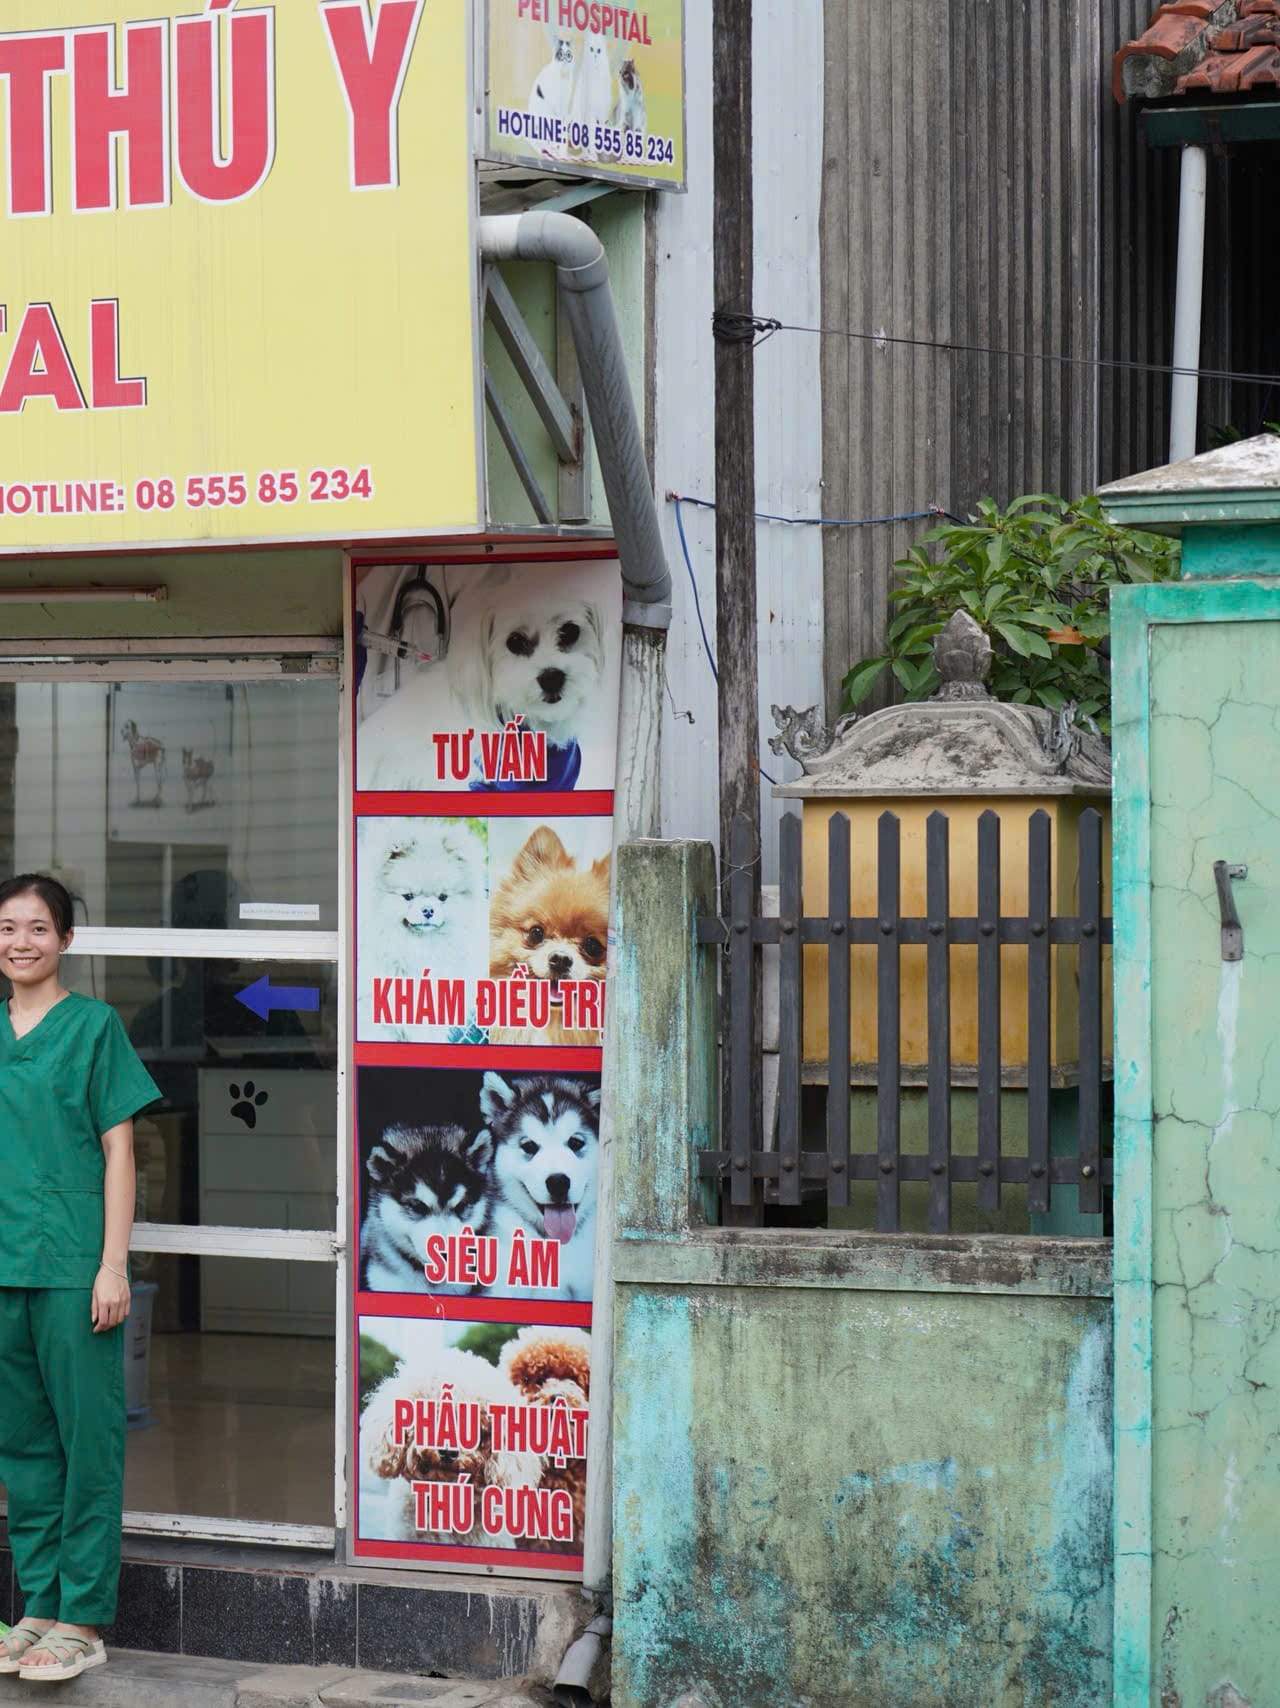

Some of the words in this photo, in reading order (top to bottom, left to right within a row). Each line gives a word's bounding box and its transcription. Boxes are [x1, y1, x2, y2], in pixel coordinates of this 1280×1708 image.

[518, 0, 549, 22] PET
[558, 0, 652, 45] HOSPITAL
[322, 0, 421, 188] Y
[498, 109, 567, 144] HOTLINE:
[572, 123, 589, 148] 08
[595, 127, 621, 154] 555
[626, 131, 643, 158] 85
[648, 137, 674, 163] 234
[136, 480, 175, 510] 08
[187, 475, 246, 507] 555
[258, 472, 298, 503] 85
[310, 469, 372, 501] 234
[432, 729, 473, 780] TƯ
[481, 716, 547, 781] VẤN
[373, 970, 464, 1026] KHÁM
[476, 966, 550, 1029] ĐIỀU
[425, 1228, 497, 1286] SIÊU
[508, 1230, 560, 1287] ÂM
[394, 1385, 479, 1449] PHẪU
[489, 1398, 589, 1467] THUẬT
[412, 1474, 474, 1533] THÚ
[482, 1485, 573, 1541] CƯNG
